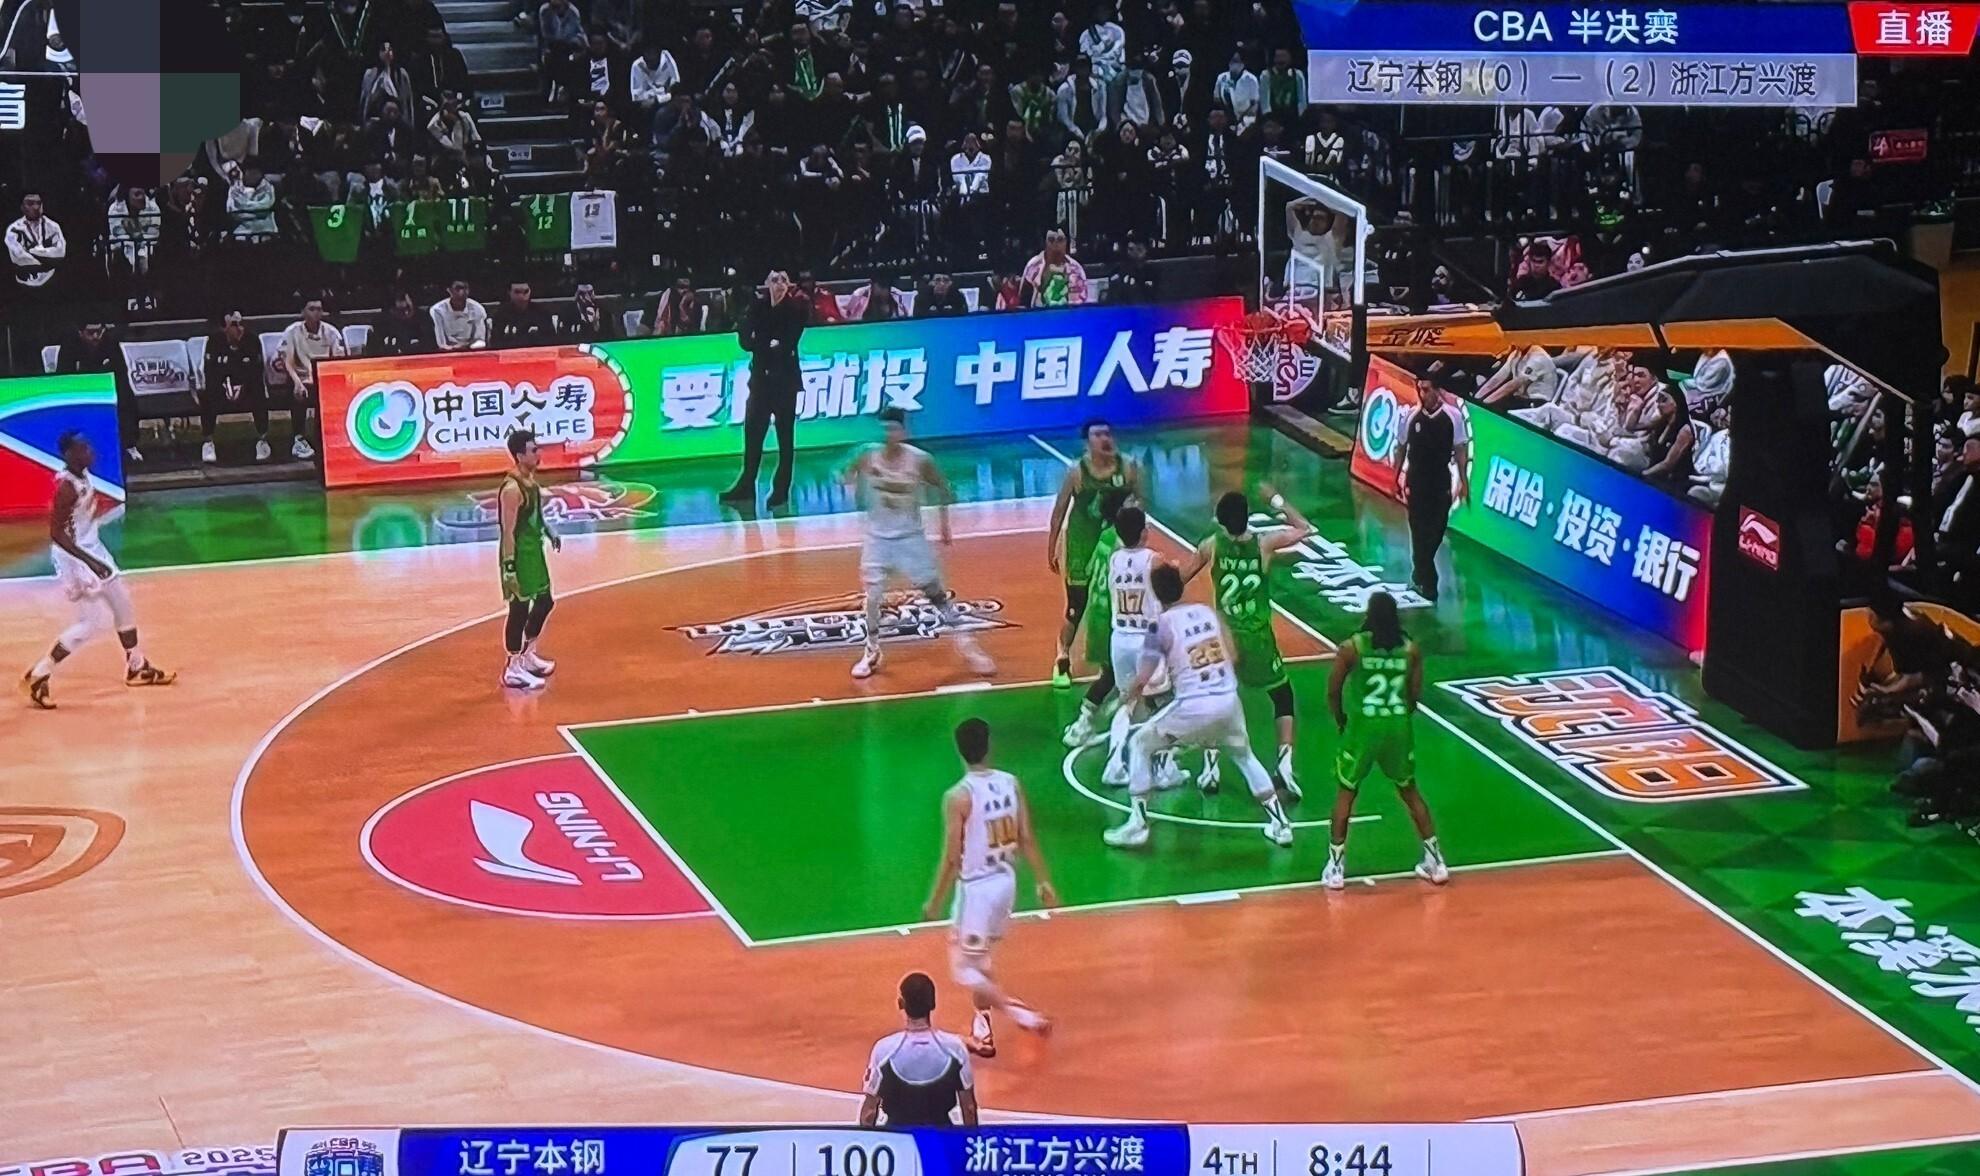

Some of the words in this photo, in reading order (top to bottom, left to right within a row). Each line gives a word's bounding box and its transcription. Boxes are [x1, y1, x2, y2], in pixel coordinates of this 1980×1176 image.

[327, 204, 347, 228] 3
[954, 326, 1214, 406] 中国人寿
[433, 383, 587, 421] 中国人寿
[1220, 573, 1262, 608] 22
